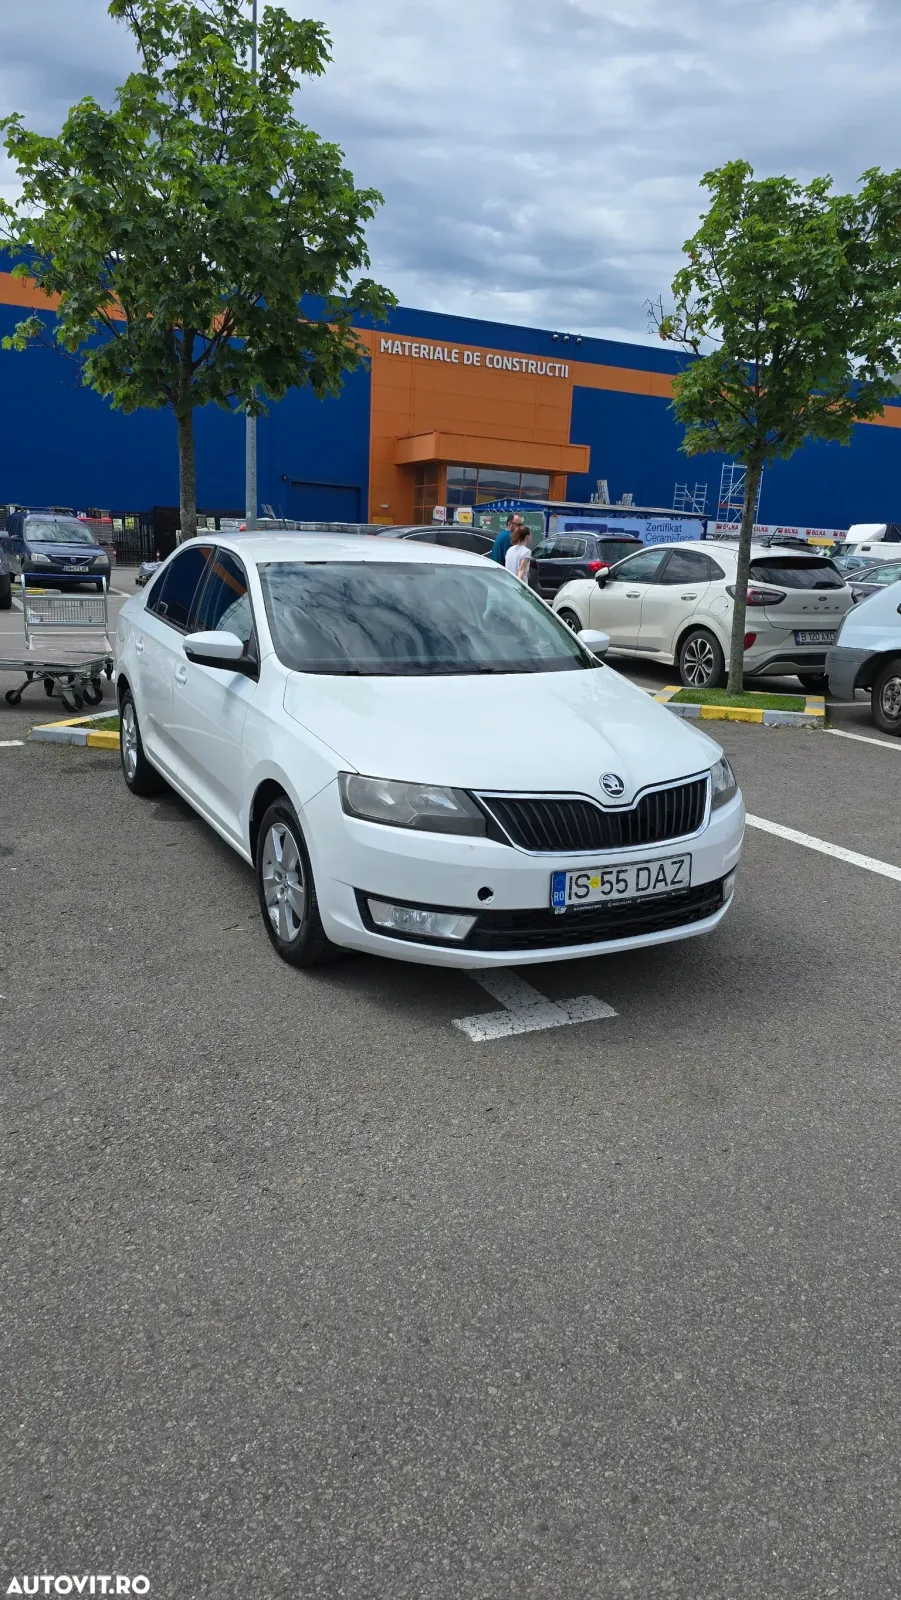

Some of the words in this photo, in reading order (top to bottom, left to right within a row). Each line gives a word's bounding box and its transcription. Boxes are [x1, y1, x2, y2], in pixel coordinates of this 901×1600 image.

[380, 338, 459, 363] MATERIALE
[463, 350, 481, 366] DE
[485, 353, 569, 378] CONSTRUCTII
[646, 522, 682, 532] Zertifikat
[783, 527, 798, 535] BILKA
[811, 529, 826, 537] BILKA
[801, 632, 807, 641] B
[809, 632, 820, 641] 120
[567, 873, 591, 901] IS
[600, 868, 628, 896] 55
[636, 860, 685, 892] DAZ
[554, 890, 565, 902] RO
